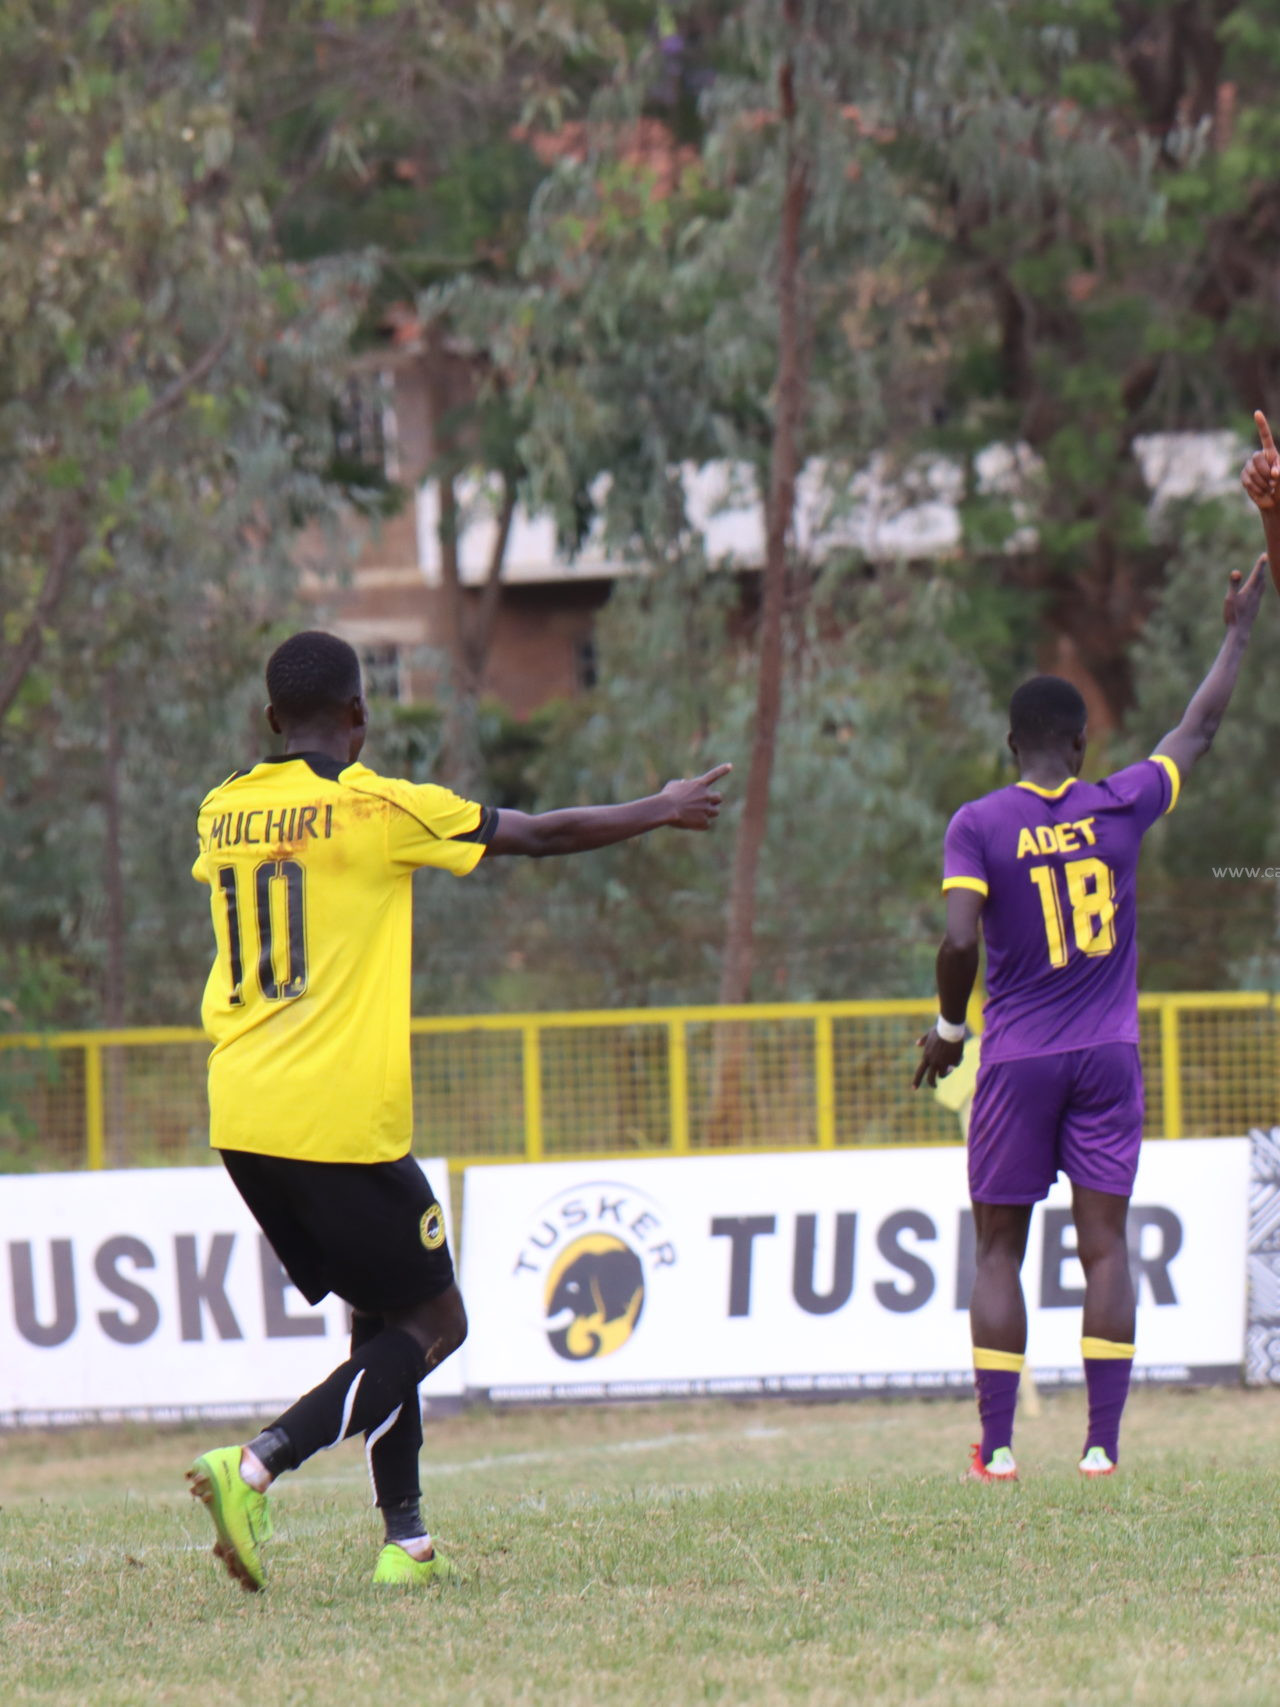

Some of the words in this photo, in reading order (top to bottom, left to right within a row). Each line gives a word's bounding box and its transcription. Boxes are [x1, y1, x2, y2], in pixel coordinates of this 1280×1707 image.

[209, 804, 332, 851] MUCHIRI
[1016, 816, 1096, 859] ADET
[217, 858, 310, 1008] 10
[1030, 856, 1119, 969] 18
[512, 1196, 678, 1278] TUSKER
[7, 1233, 353, 1348] USKE
